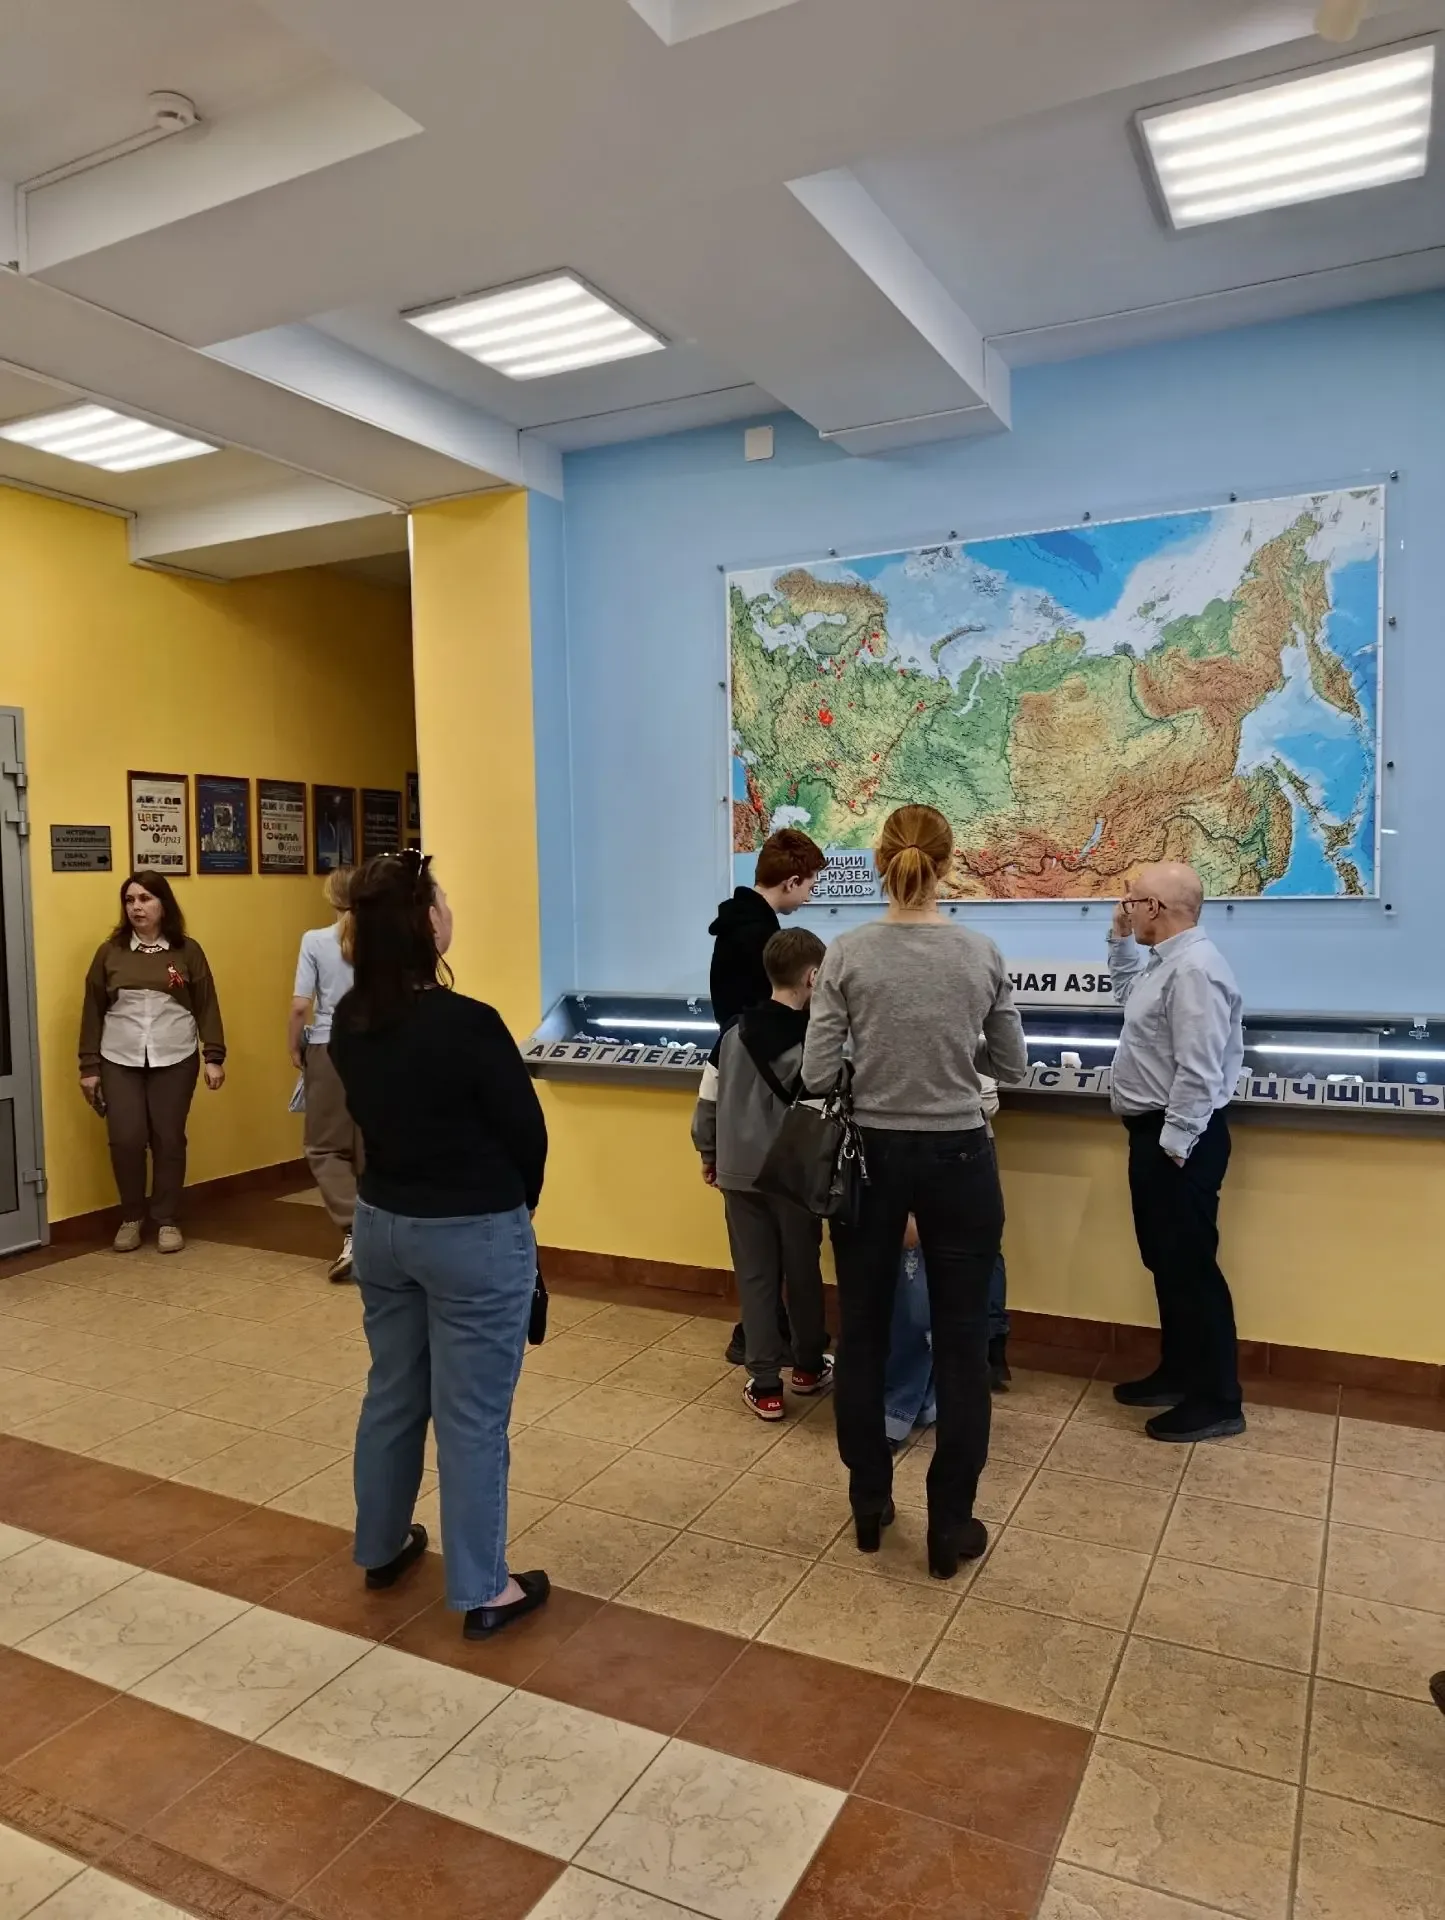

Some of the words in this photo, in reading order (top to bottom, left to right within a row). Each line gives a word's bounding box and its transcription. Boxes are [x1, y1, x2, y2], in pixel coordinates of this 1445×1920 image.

[137, 813, 165, 824] ЦВЕТ
[825, 855, 865, 868] ИЦИИ
[811, 884, 873, 895] С-КЛИО»
[1008, 973, 1057, 992] НАЯ
[1063, 973, 1113, 993] АЗБ
